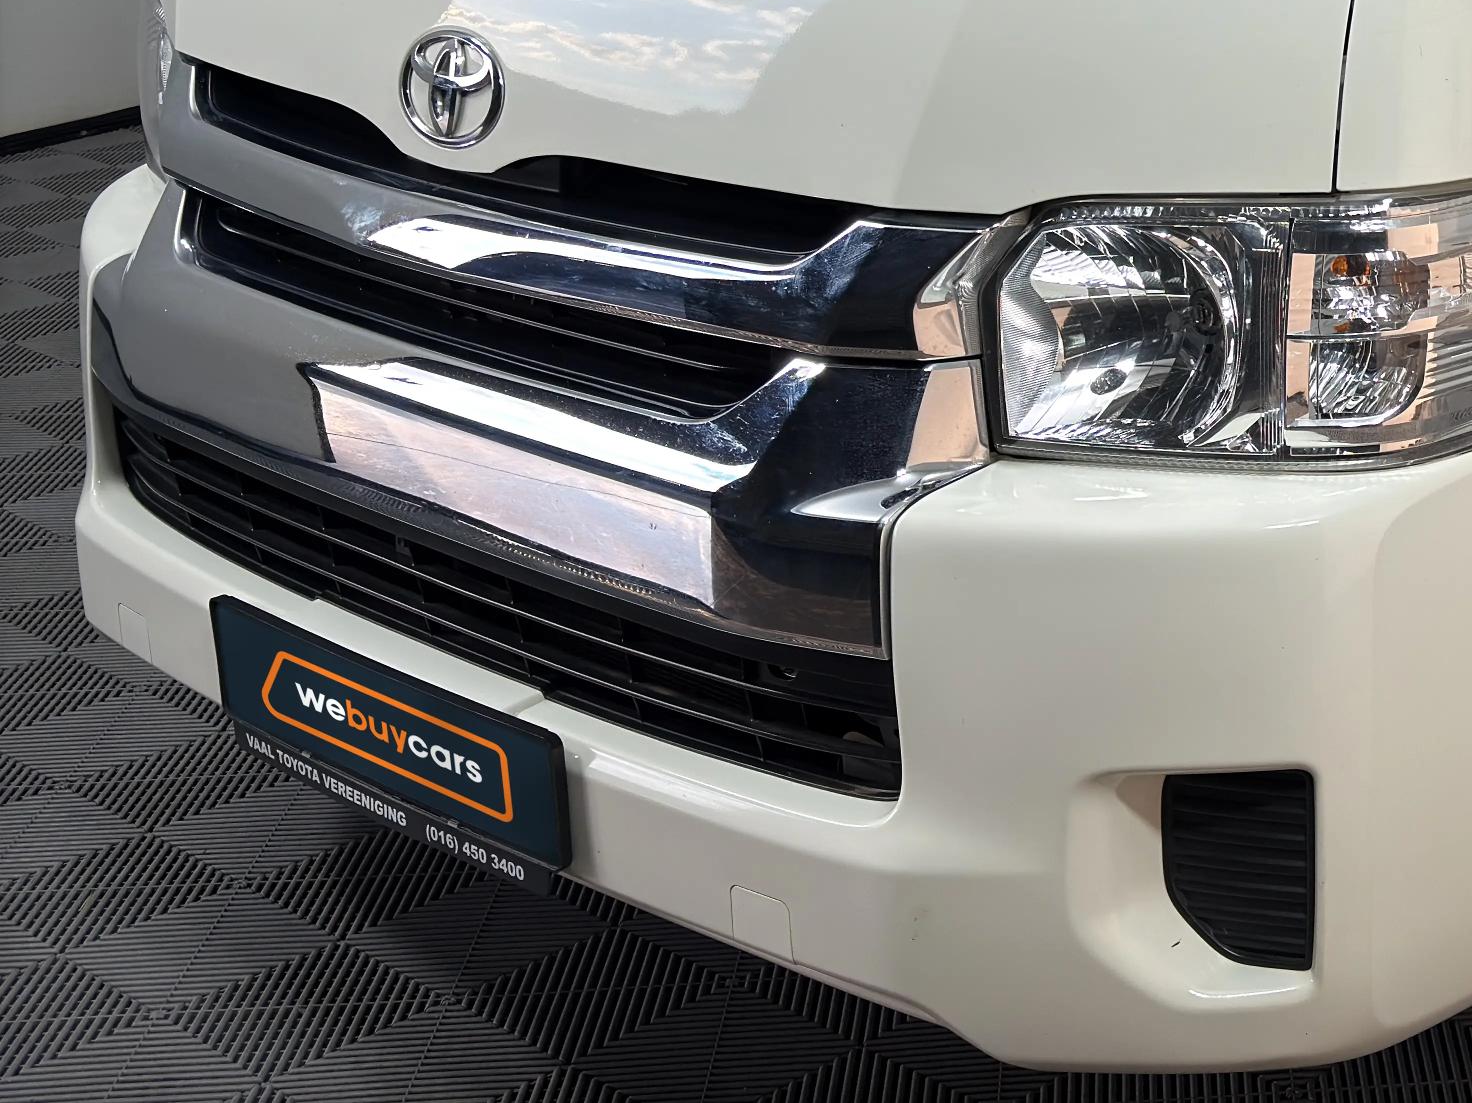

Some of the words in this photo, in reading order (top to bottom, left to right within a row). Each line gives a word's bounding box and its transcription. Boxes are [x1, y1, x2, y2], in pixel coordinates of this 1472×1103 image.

[294, 681, 483, 784] webuycars
[246, 732, 275, 761] VAAL
[276, 748, 321, 784] TOYOTA
[322, 773, 408, 827] VEREENIGING
[425, 824, 459, 854] (016)
[462, 843, 487, 864] 450
[491, 853, 525, 881] 3400
